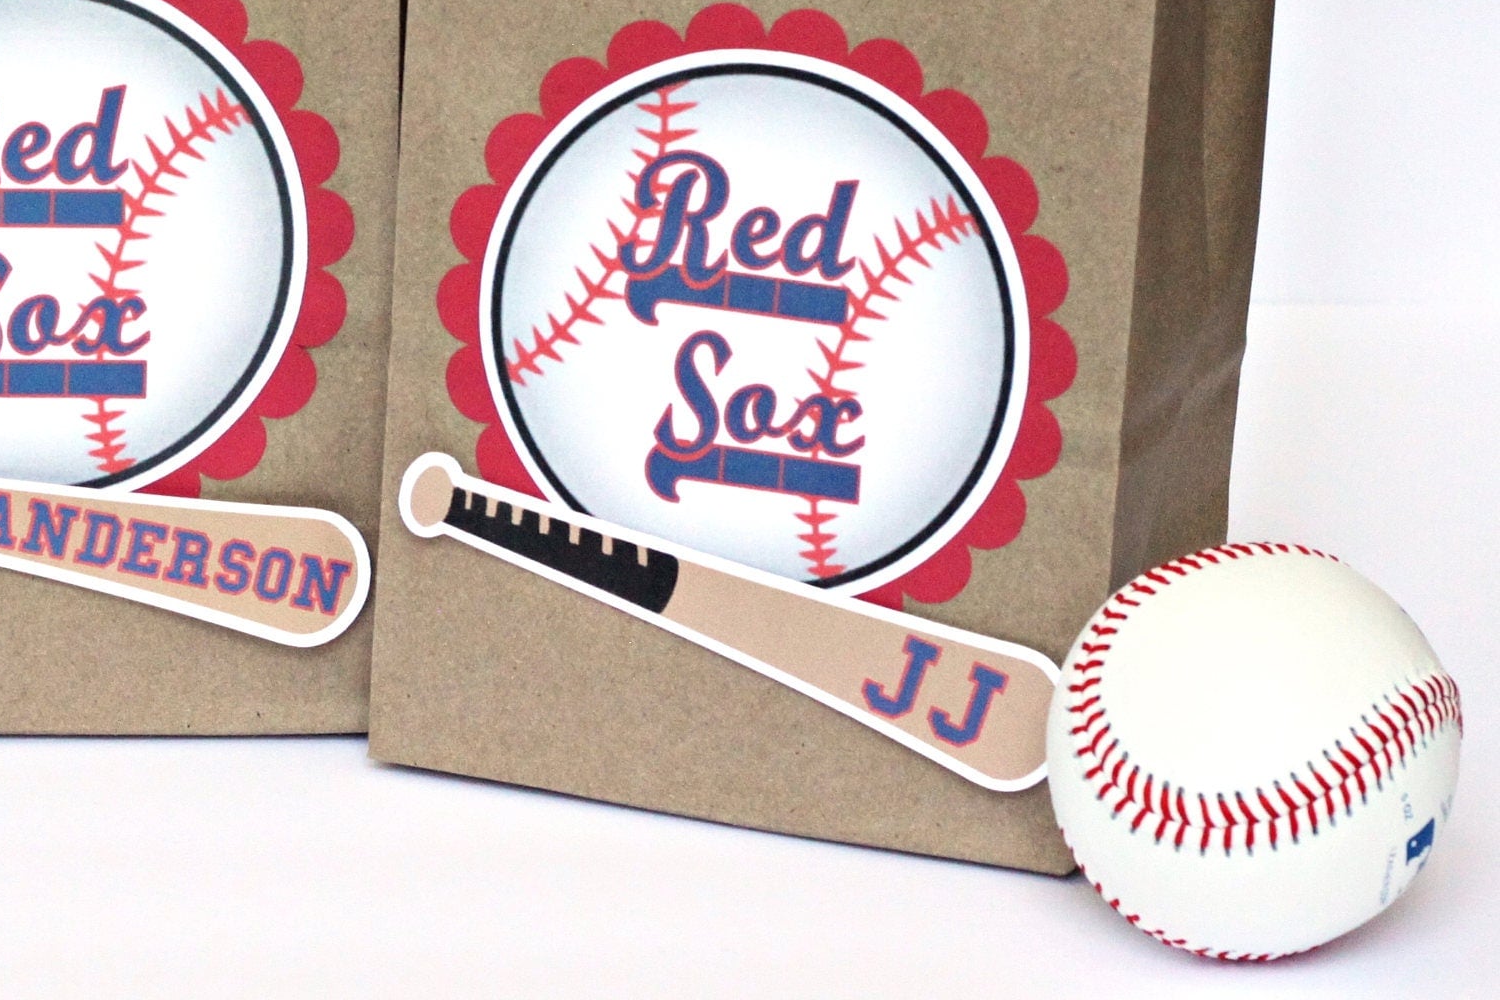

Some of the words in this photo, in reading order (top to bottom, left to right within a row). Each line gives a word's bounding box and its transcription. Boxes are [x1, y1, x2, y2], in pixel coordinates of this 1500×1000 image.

[617, 150, 860, 290] Red
[654, 330, 865, 461] Sox
[861, 634, 1009, 748] JJ
